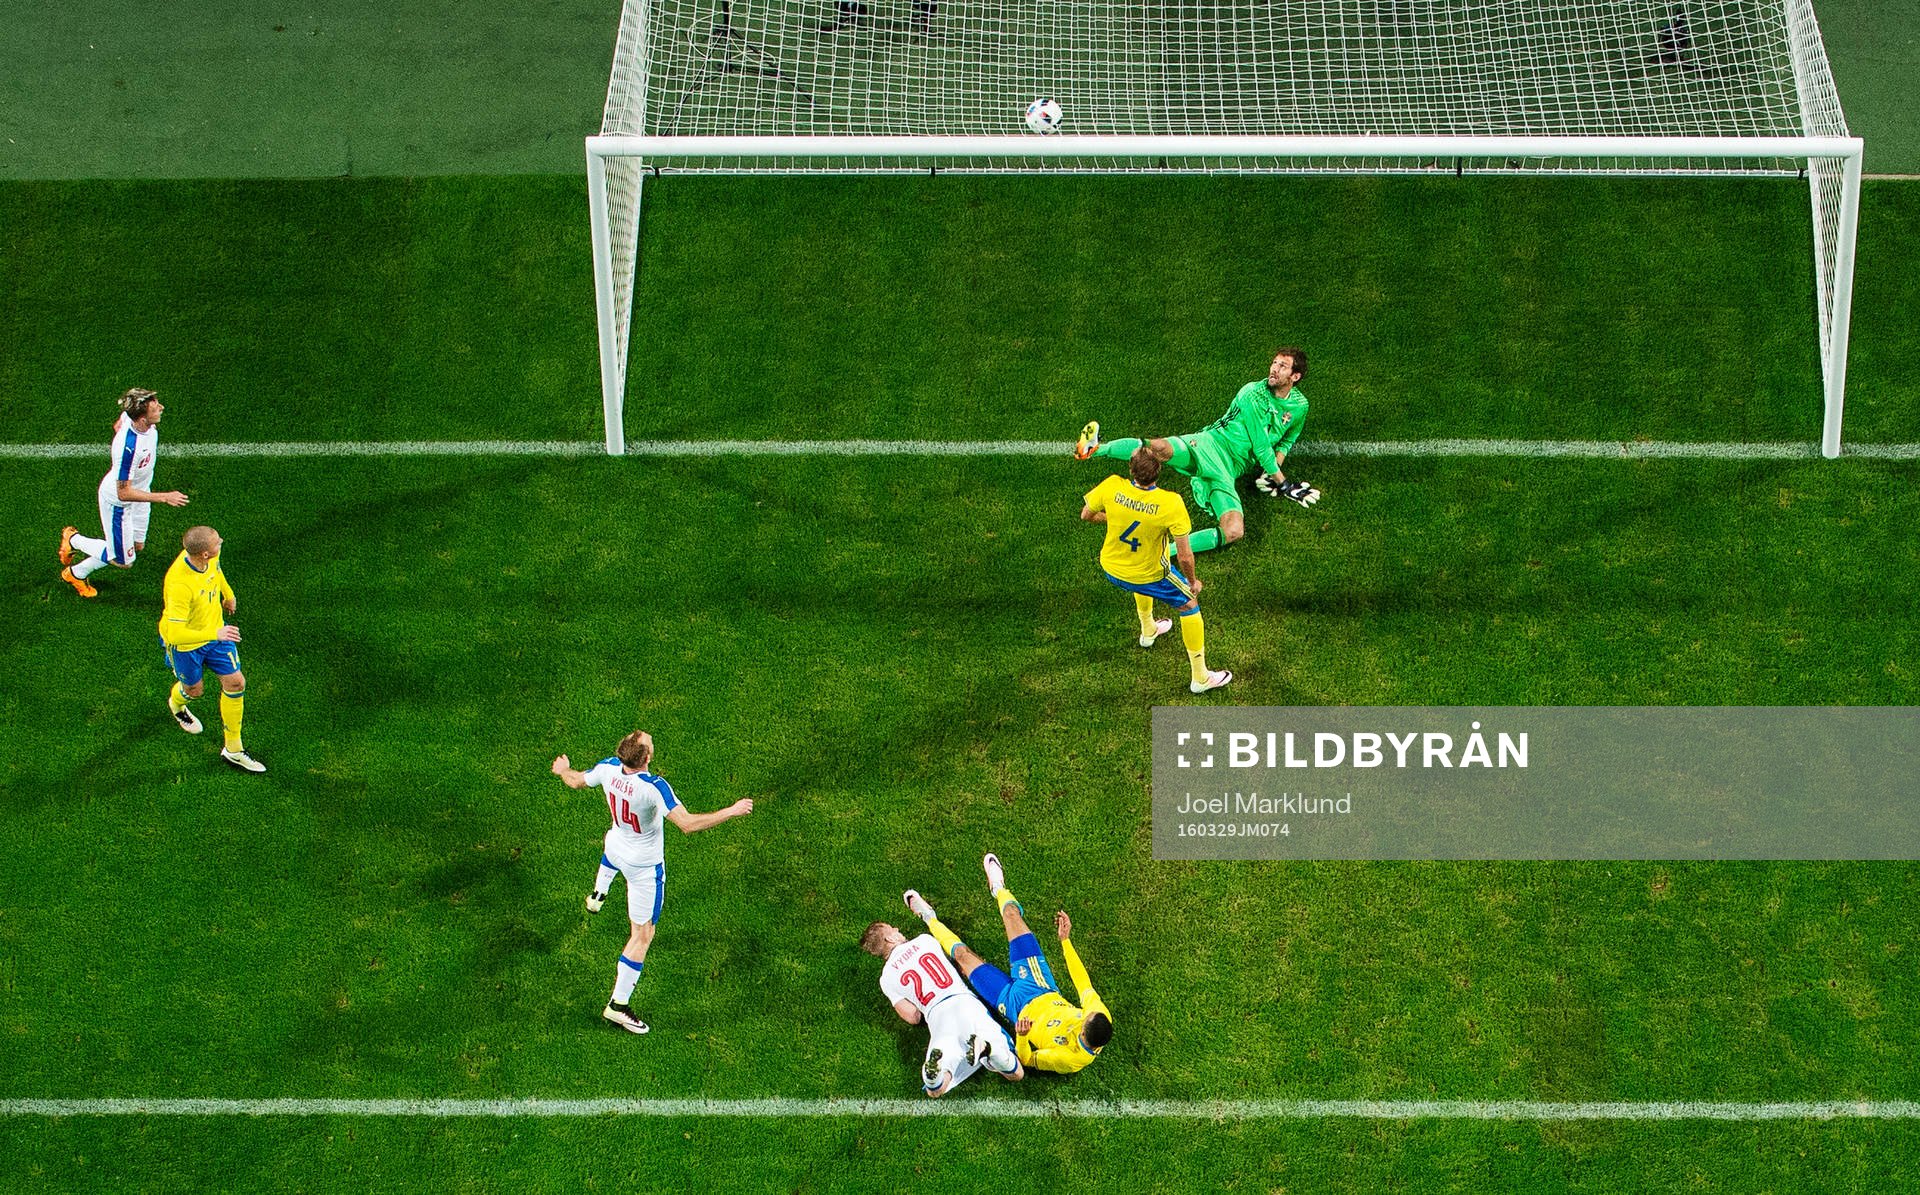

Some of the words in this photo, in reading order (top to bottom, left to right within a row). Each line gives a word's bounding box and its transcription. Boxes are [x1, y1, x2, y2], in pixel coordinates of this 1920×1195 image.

[1114, 491, 1160, 516] GRANQVIST
[1119, 520, 1142, 553] 4
[609, 791, 642, 835] 14
[891, 943, 921, 970] VYDRA
[900, 952, 954, 1007] 20
